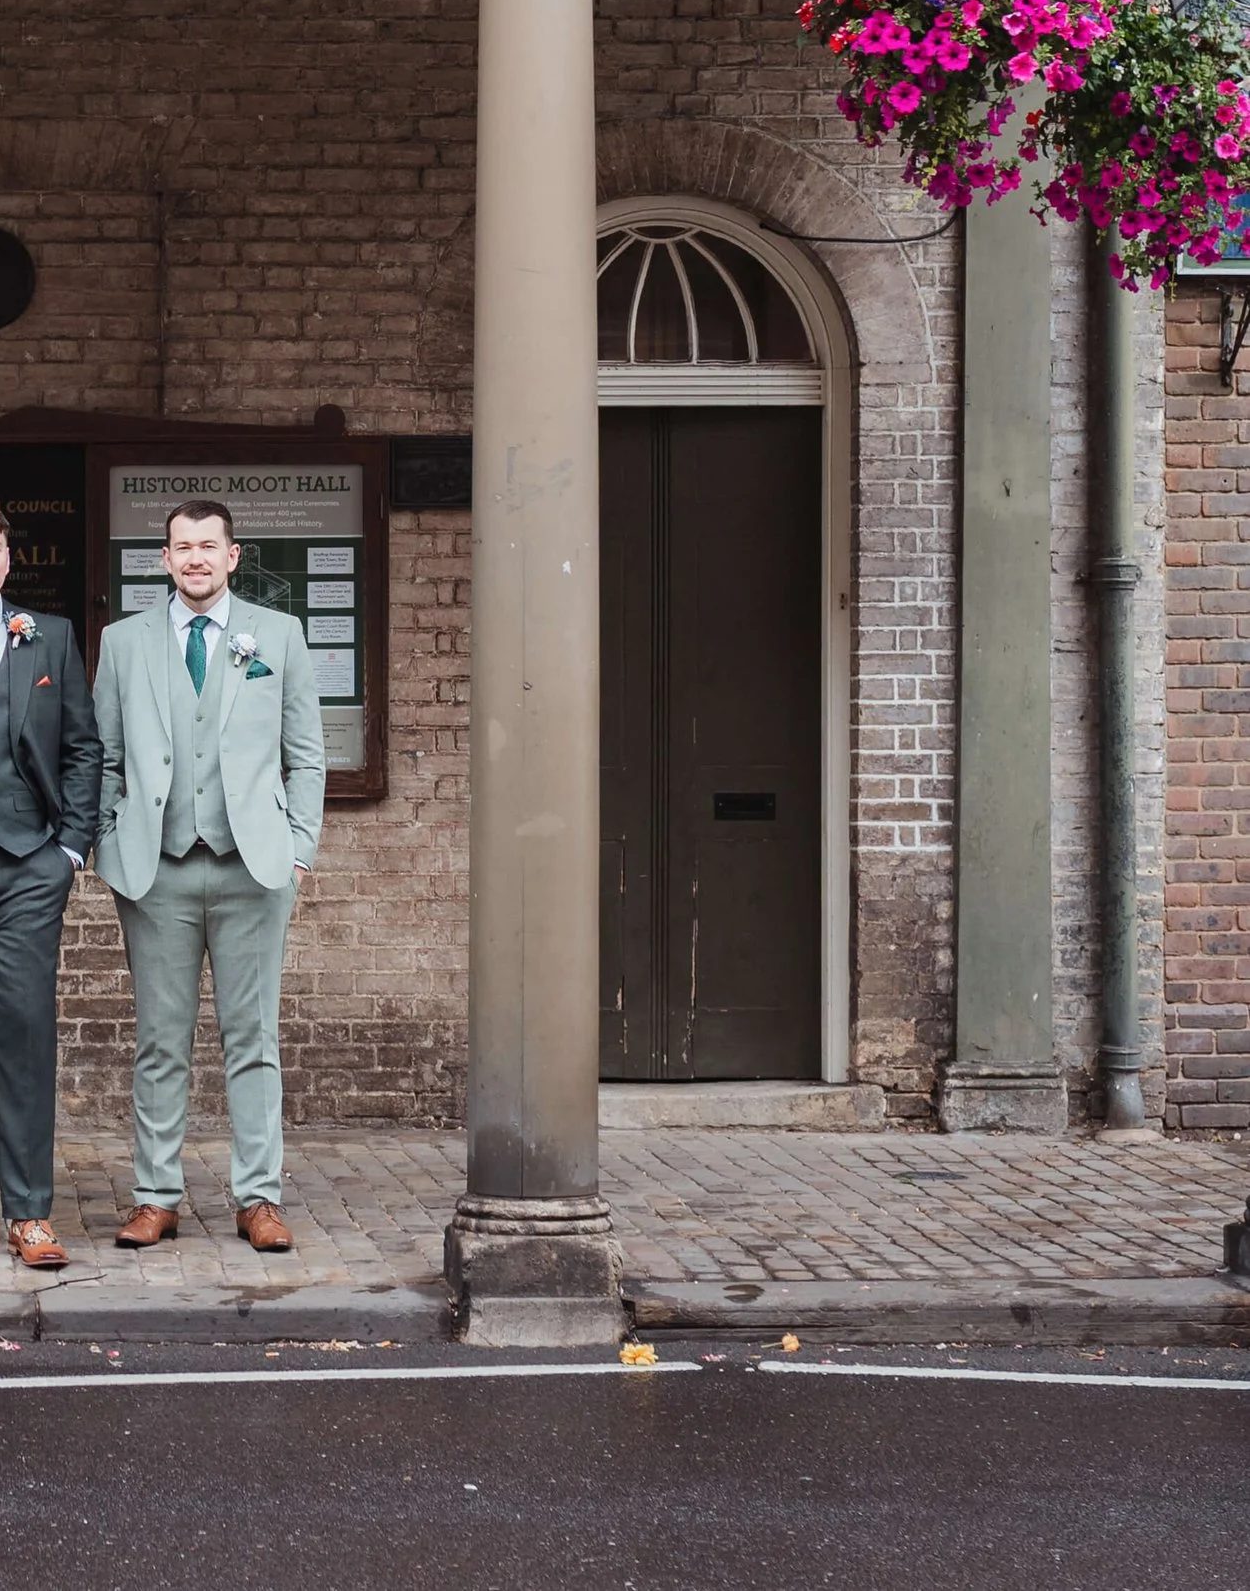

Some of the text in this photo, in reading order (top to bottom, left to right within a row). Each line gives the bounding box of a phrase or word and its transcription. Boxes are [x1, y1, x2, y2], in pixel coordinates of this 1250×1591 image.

[122, 475, 351, 494] HISTORIC MOOT HALL
[6, 500, 76, 514] COUNCIL
[234, 520, 241, 528] of
[242, 520, 274, 528] Maldon's
[275, 520, 296, 528] Social
[11, 545, 67, 566] ALL
